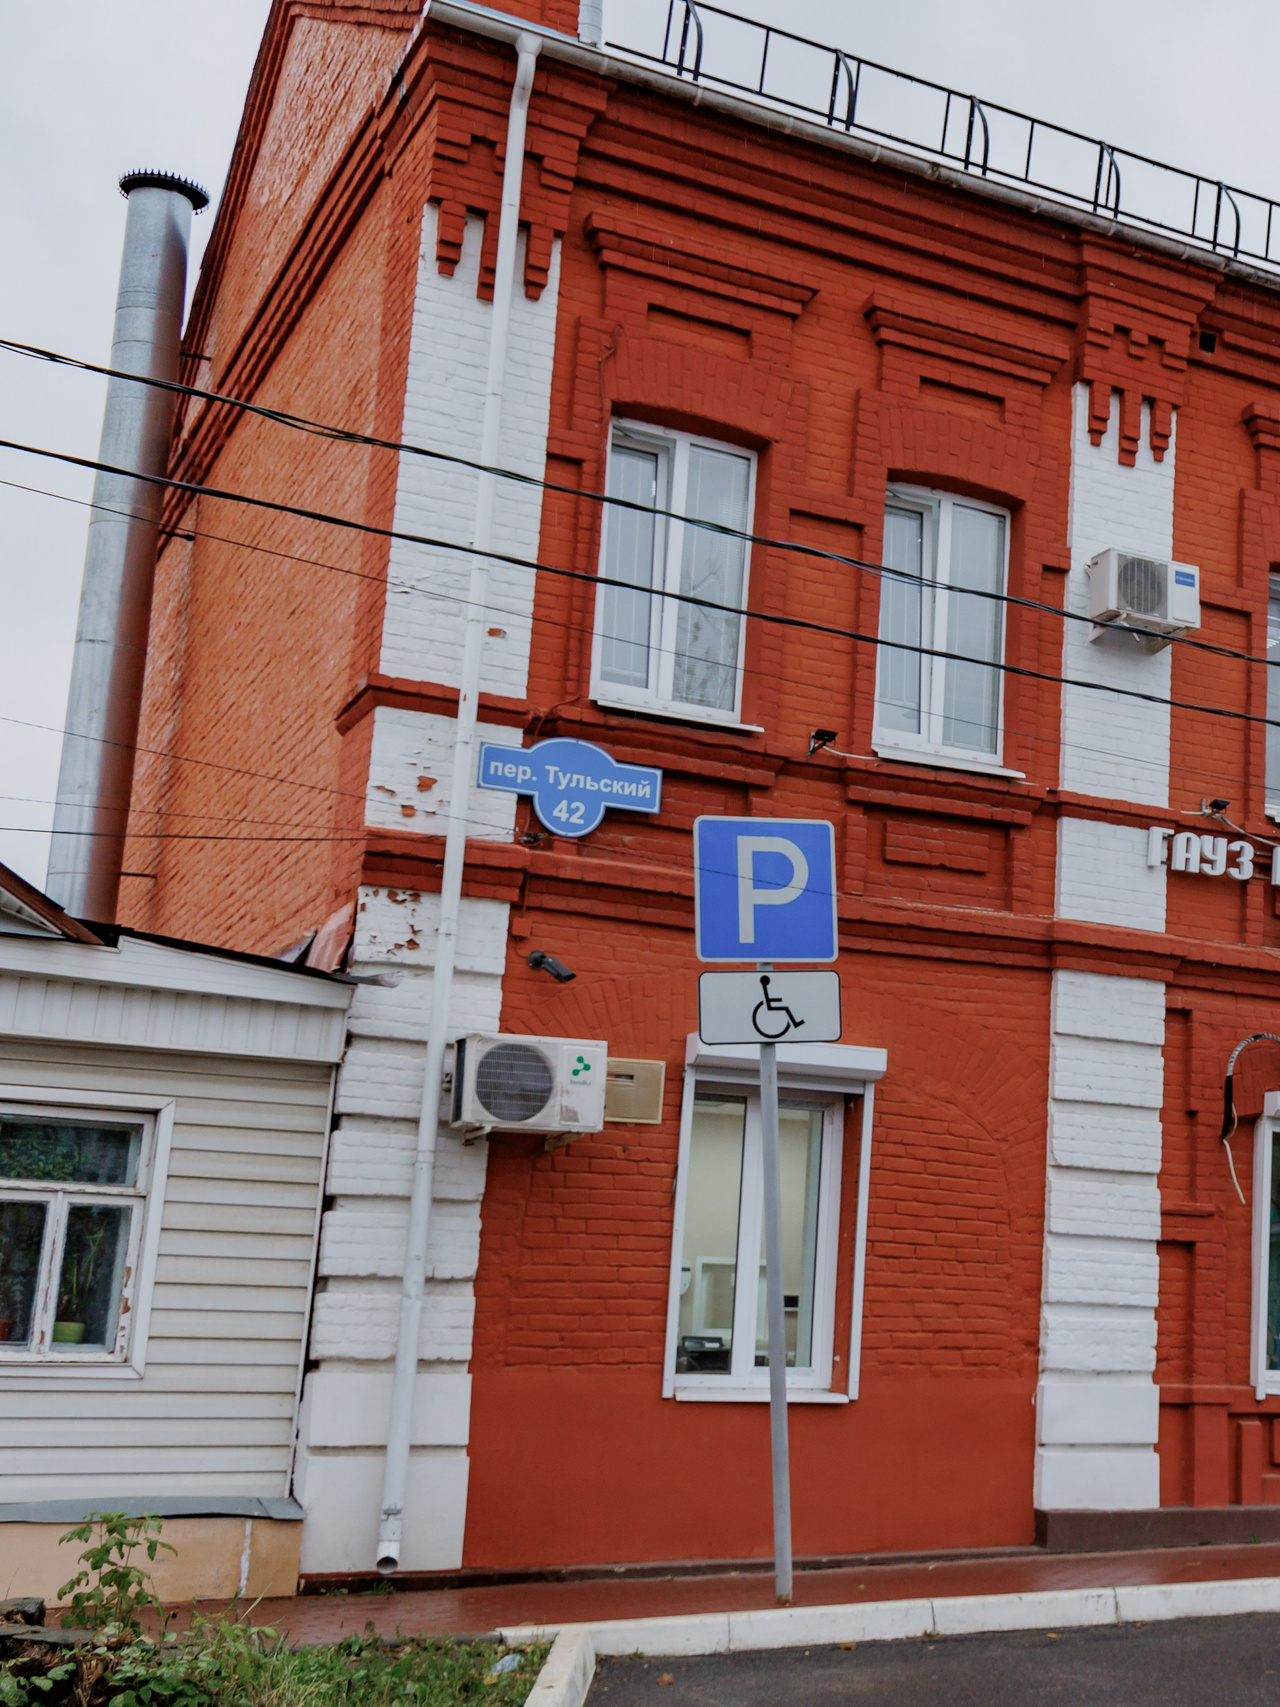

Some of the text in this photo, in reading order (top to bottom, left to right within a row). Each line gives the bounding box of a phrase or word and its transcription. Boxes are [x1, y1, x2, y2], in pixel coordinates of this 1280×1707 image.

[489, 761, 651, 798] пер. Тульский
[552, 799, 586, 825] 42
[1147, 826, 1255, 881] ГАУЗ
[736, 835, 810, 944] P
